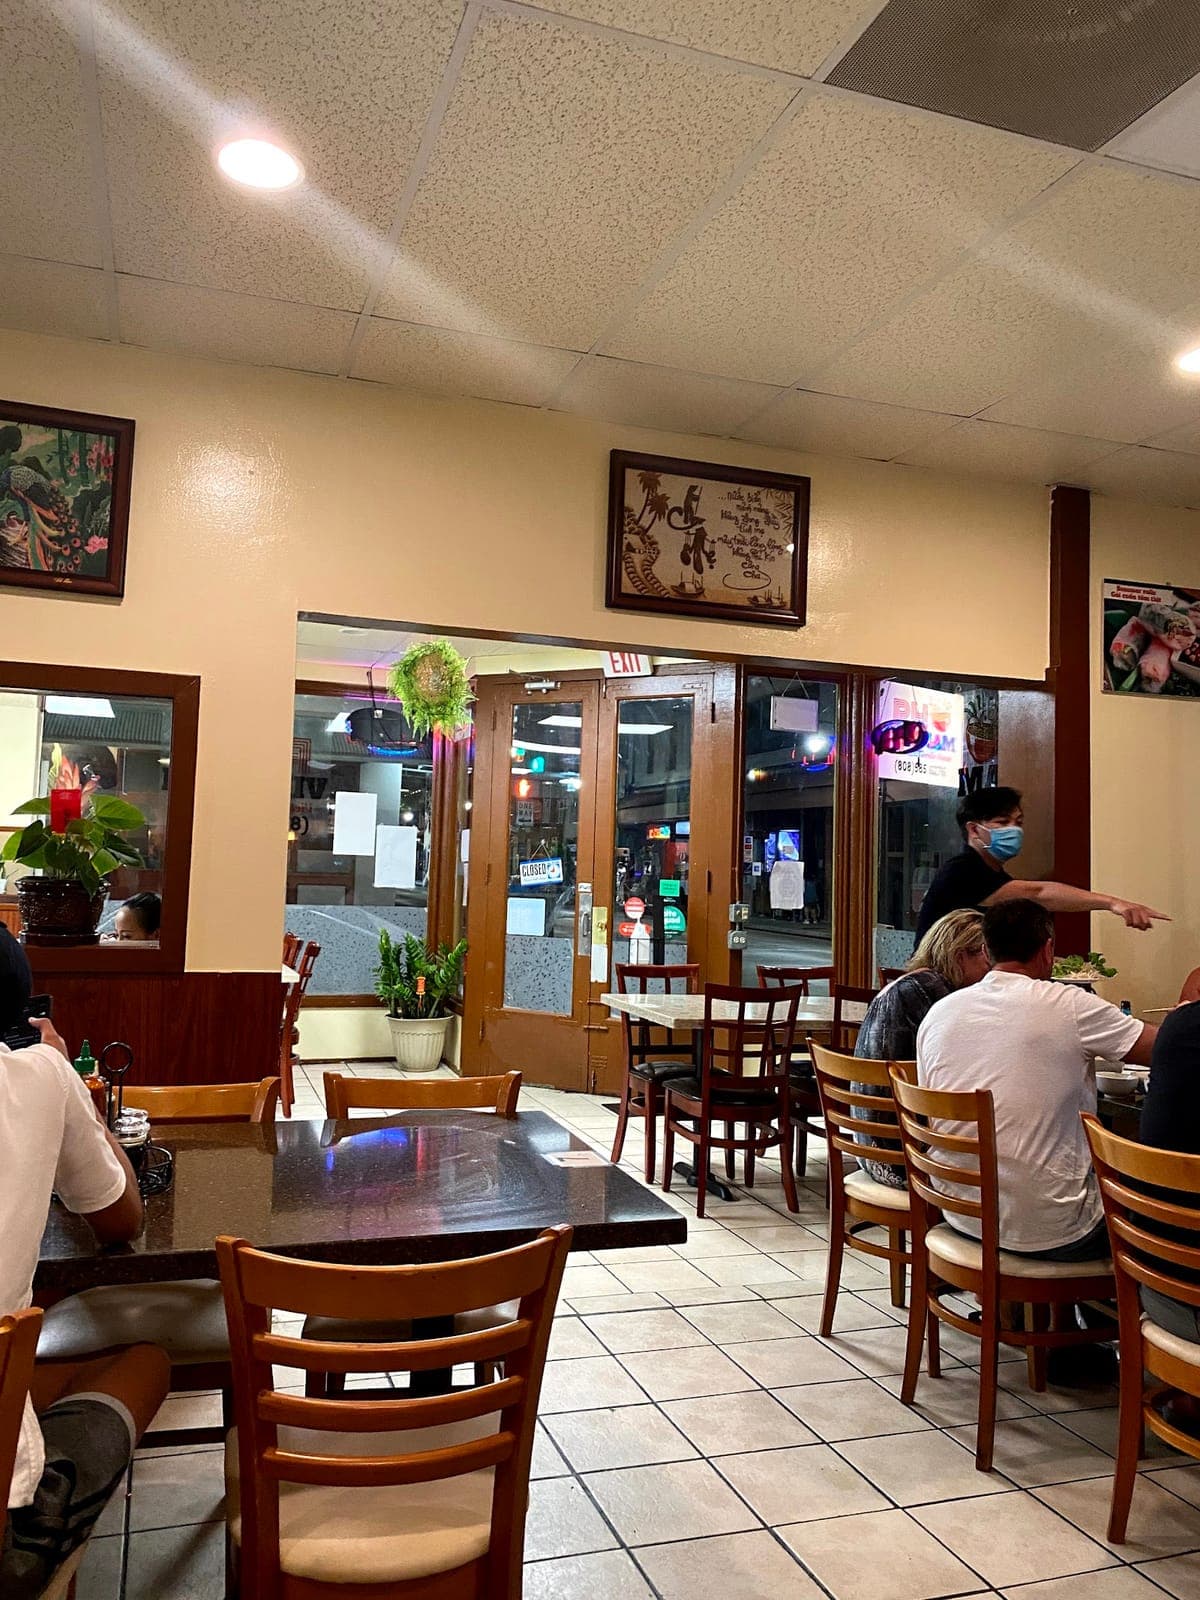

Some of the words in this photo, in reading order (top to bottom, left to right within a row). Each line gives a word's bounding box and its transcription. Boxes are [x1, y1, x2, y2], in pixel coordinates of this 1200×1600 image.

[609, 650, 641, 673] EXIT
[518, 810, 532, 818] WAY
[521, 862, 547, 877] CLOSED
